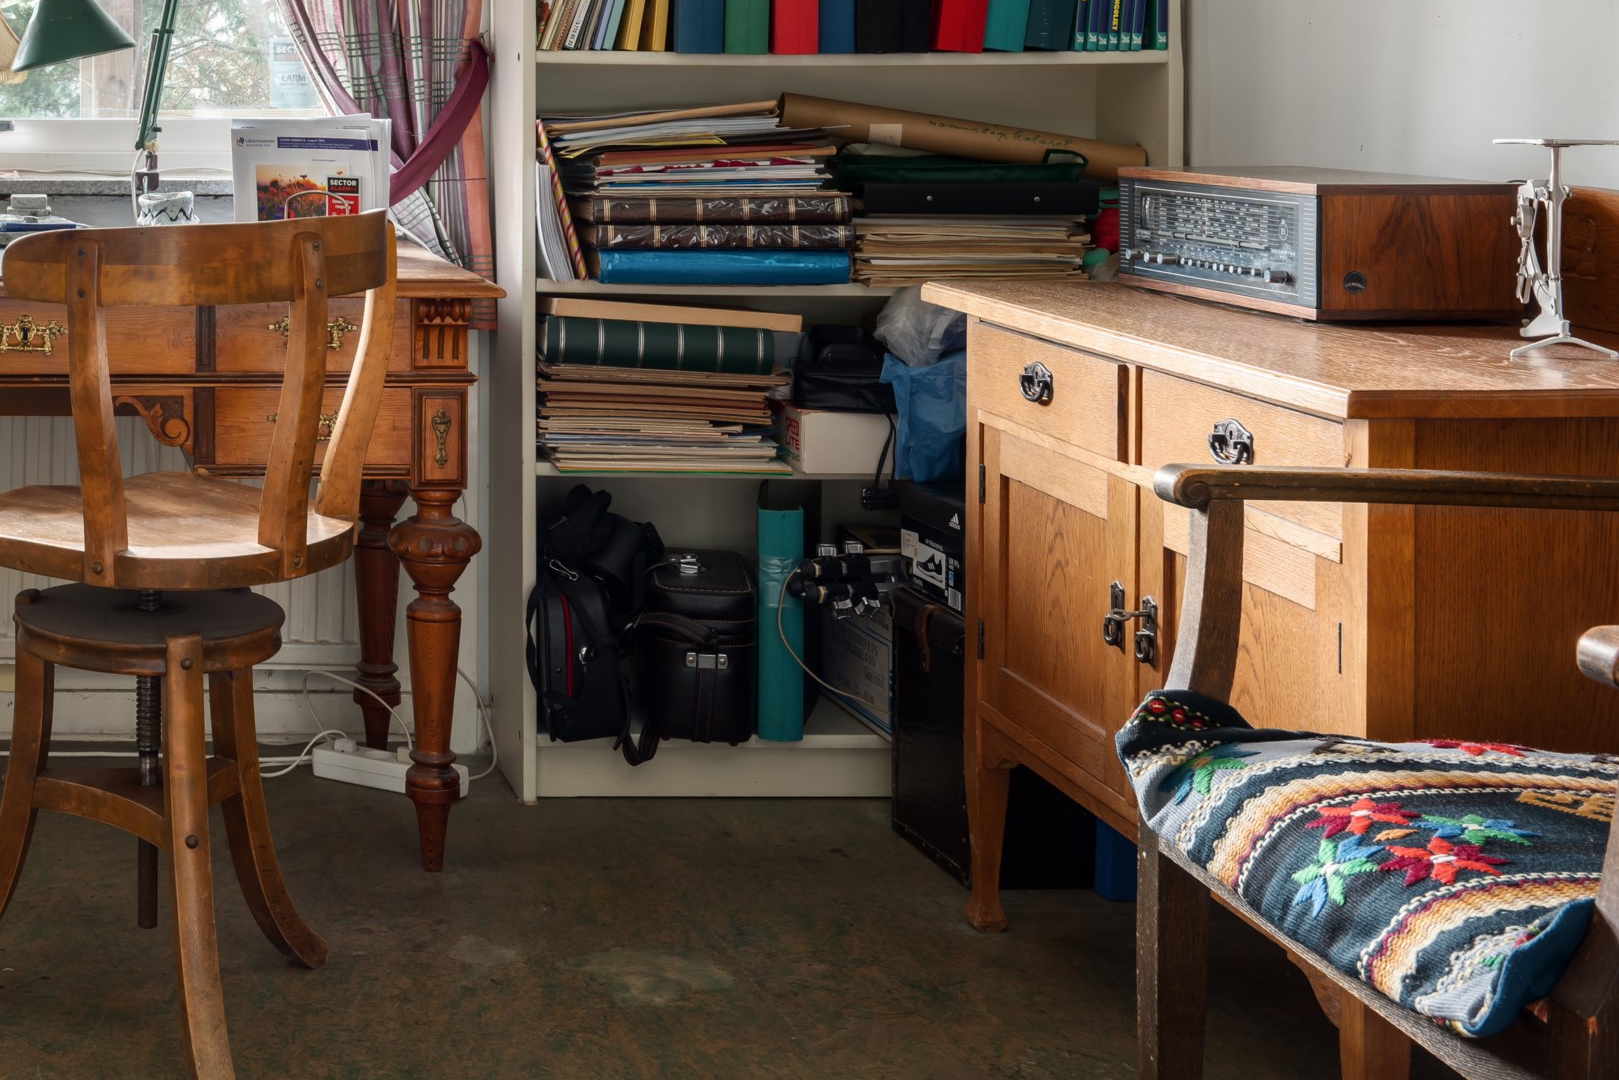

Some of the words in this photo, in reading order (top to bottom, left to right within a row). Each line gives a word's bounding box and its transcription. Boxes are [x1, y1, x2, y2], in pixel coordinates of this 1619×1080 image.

[281, 74, 306, 82] LARM
[330, 179, 357, 187] SECTOR
[785, 415, 800, 437] SPEED
[785, 431, 800, 451] LITE
